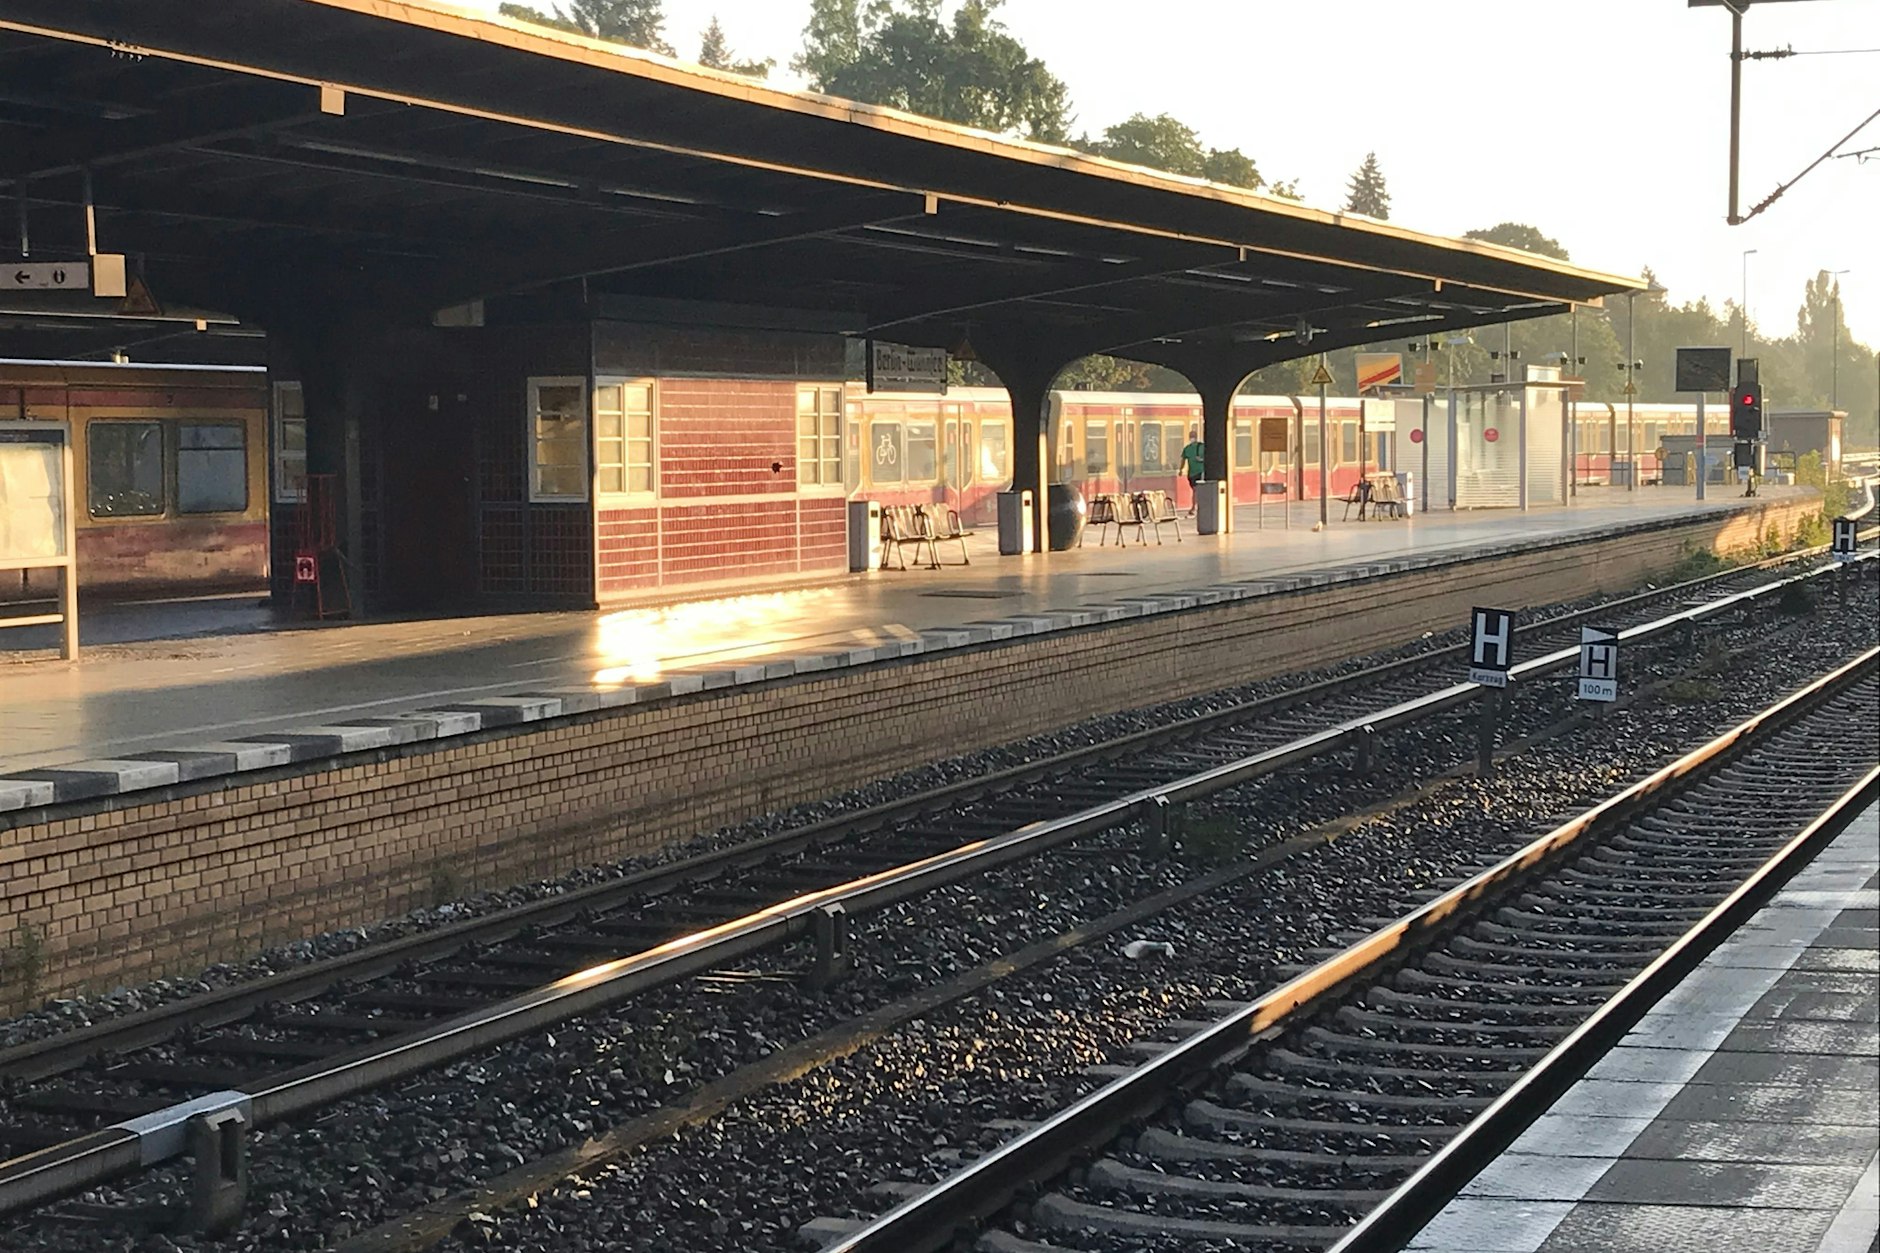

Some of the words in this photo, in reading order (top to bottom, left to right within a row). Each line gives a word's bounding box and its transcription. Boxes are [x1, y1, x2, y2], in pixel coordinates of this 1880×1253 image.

[1836, 522, 1855, 550] H
[1473, 612, 1508, 664] H
[1587, 646, 1609, 676] H
[1583, 684, 1601, 695] 100
[1601, 686, 1612, 695] m
